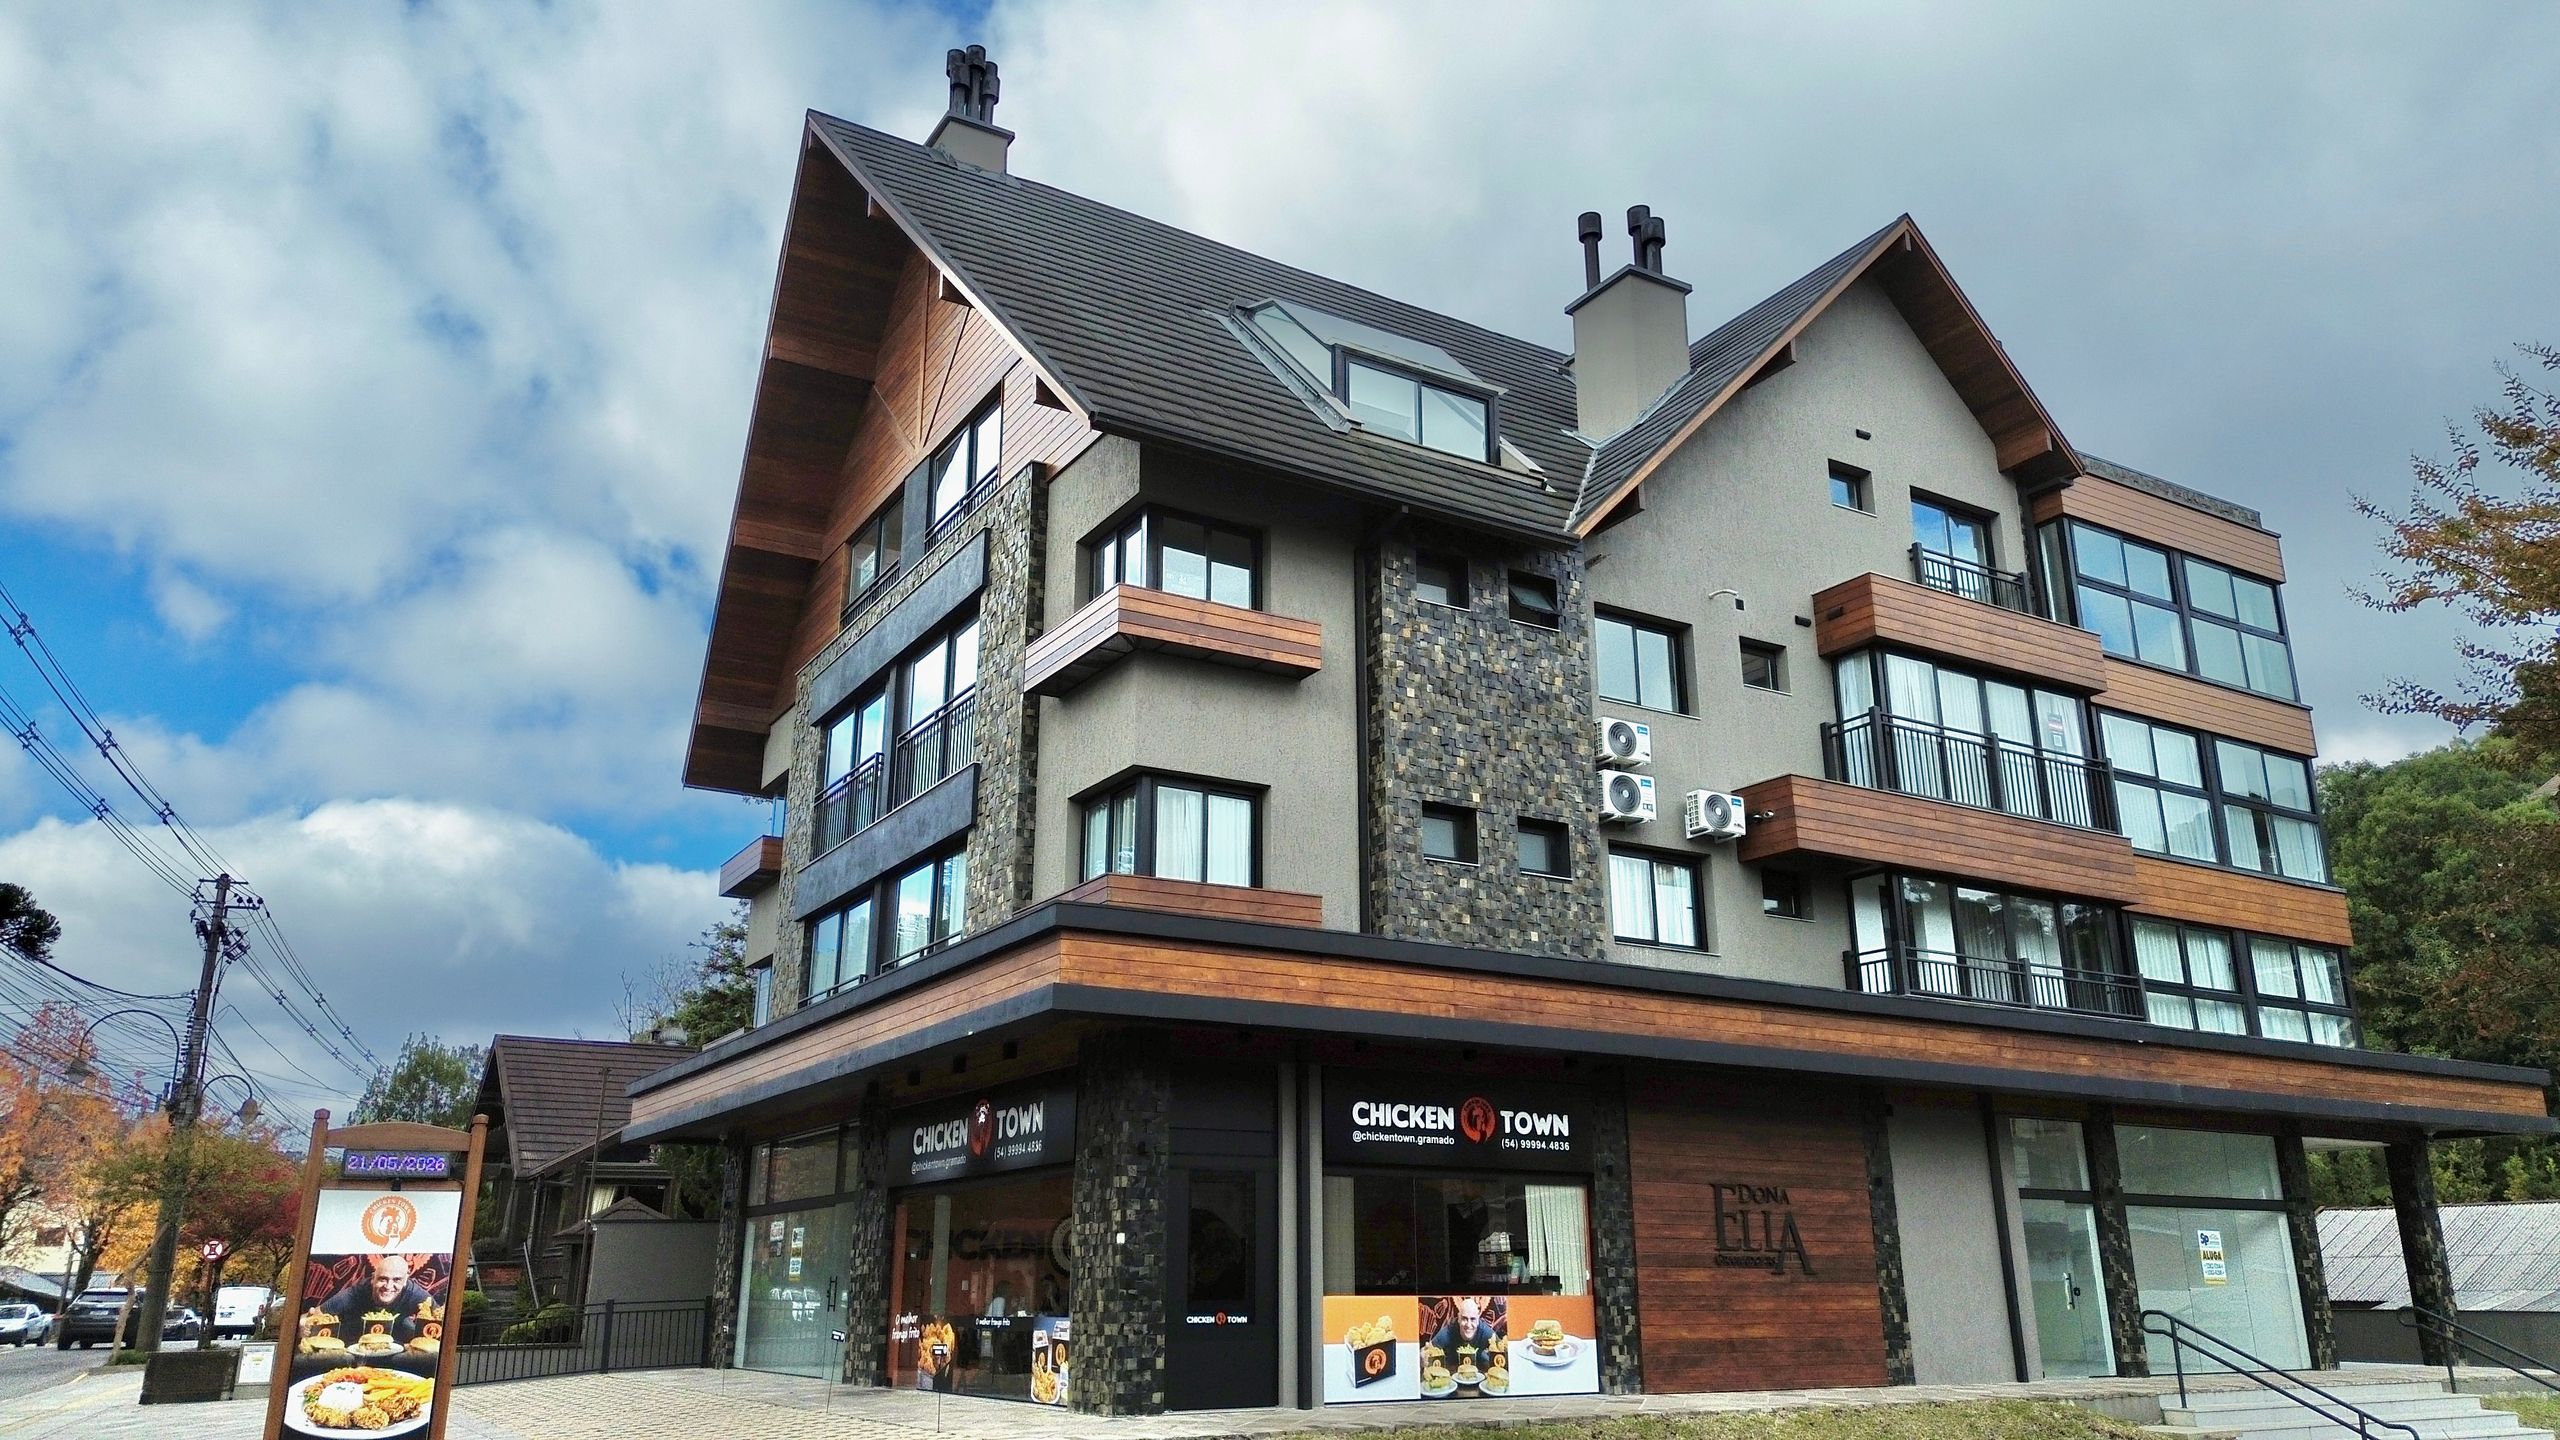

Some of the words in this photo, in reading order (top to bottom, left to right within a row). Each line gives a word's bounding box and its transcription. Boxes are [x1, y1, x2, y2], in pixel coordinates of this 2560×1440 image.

[1352, 1101, 1455, 1131] CHICKEN
[1499, 1110, 1570, 1137] TOWN
[913, 1117, 969, 1156] CHICKEN
[996, 1101, 1044, 1140] TOWN
[1352, 1130, 1455, 1145] @chickentown.gramado
[1501, 1137, 1519, 1151] (54)
[1520, 1139, 1570, 1152] 99994.4836
[994, 1148, 1007, 1161] (54)
[347, 1154, 445, 1171] 21/05/2026
[1738, 1183, 1790, 1205] DONA
[2202, 1250, 2222, 1261] ALUGA
[1186, 1316, 1215, 1324] CHICKEN
[1227, 1316, 1248, 1324] TOWN
